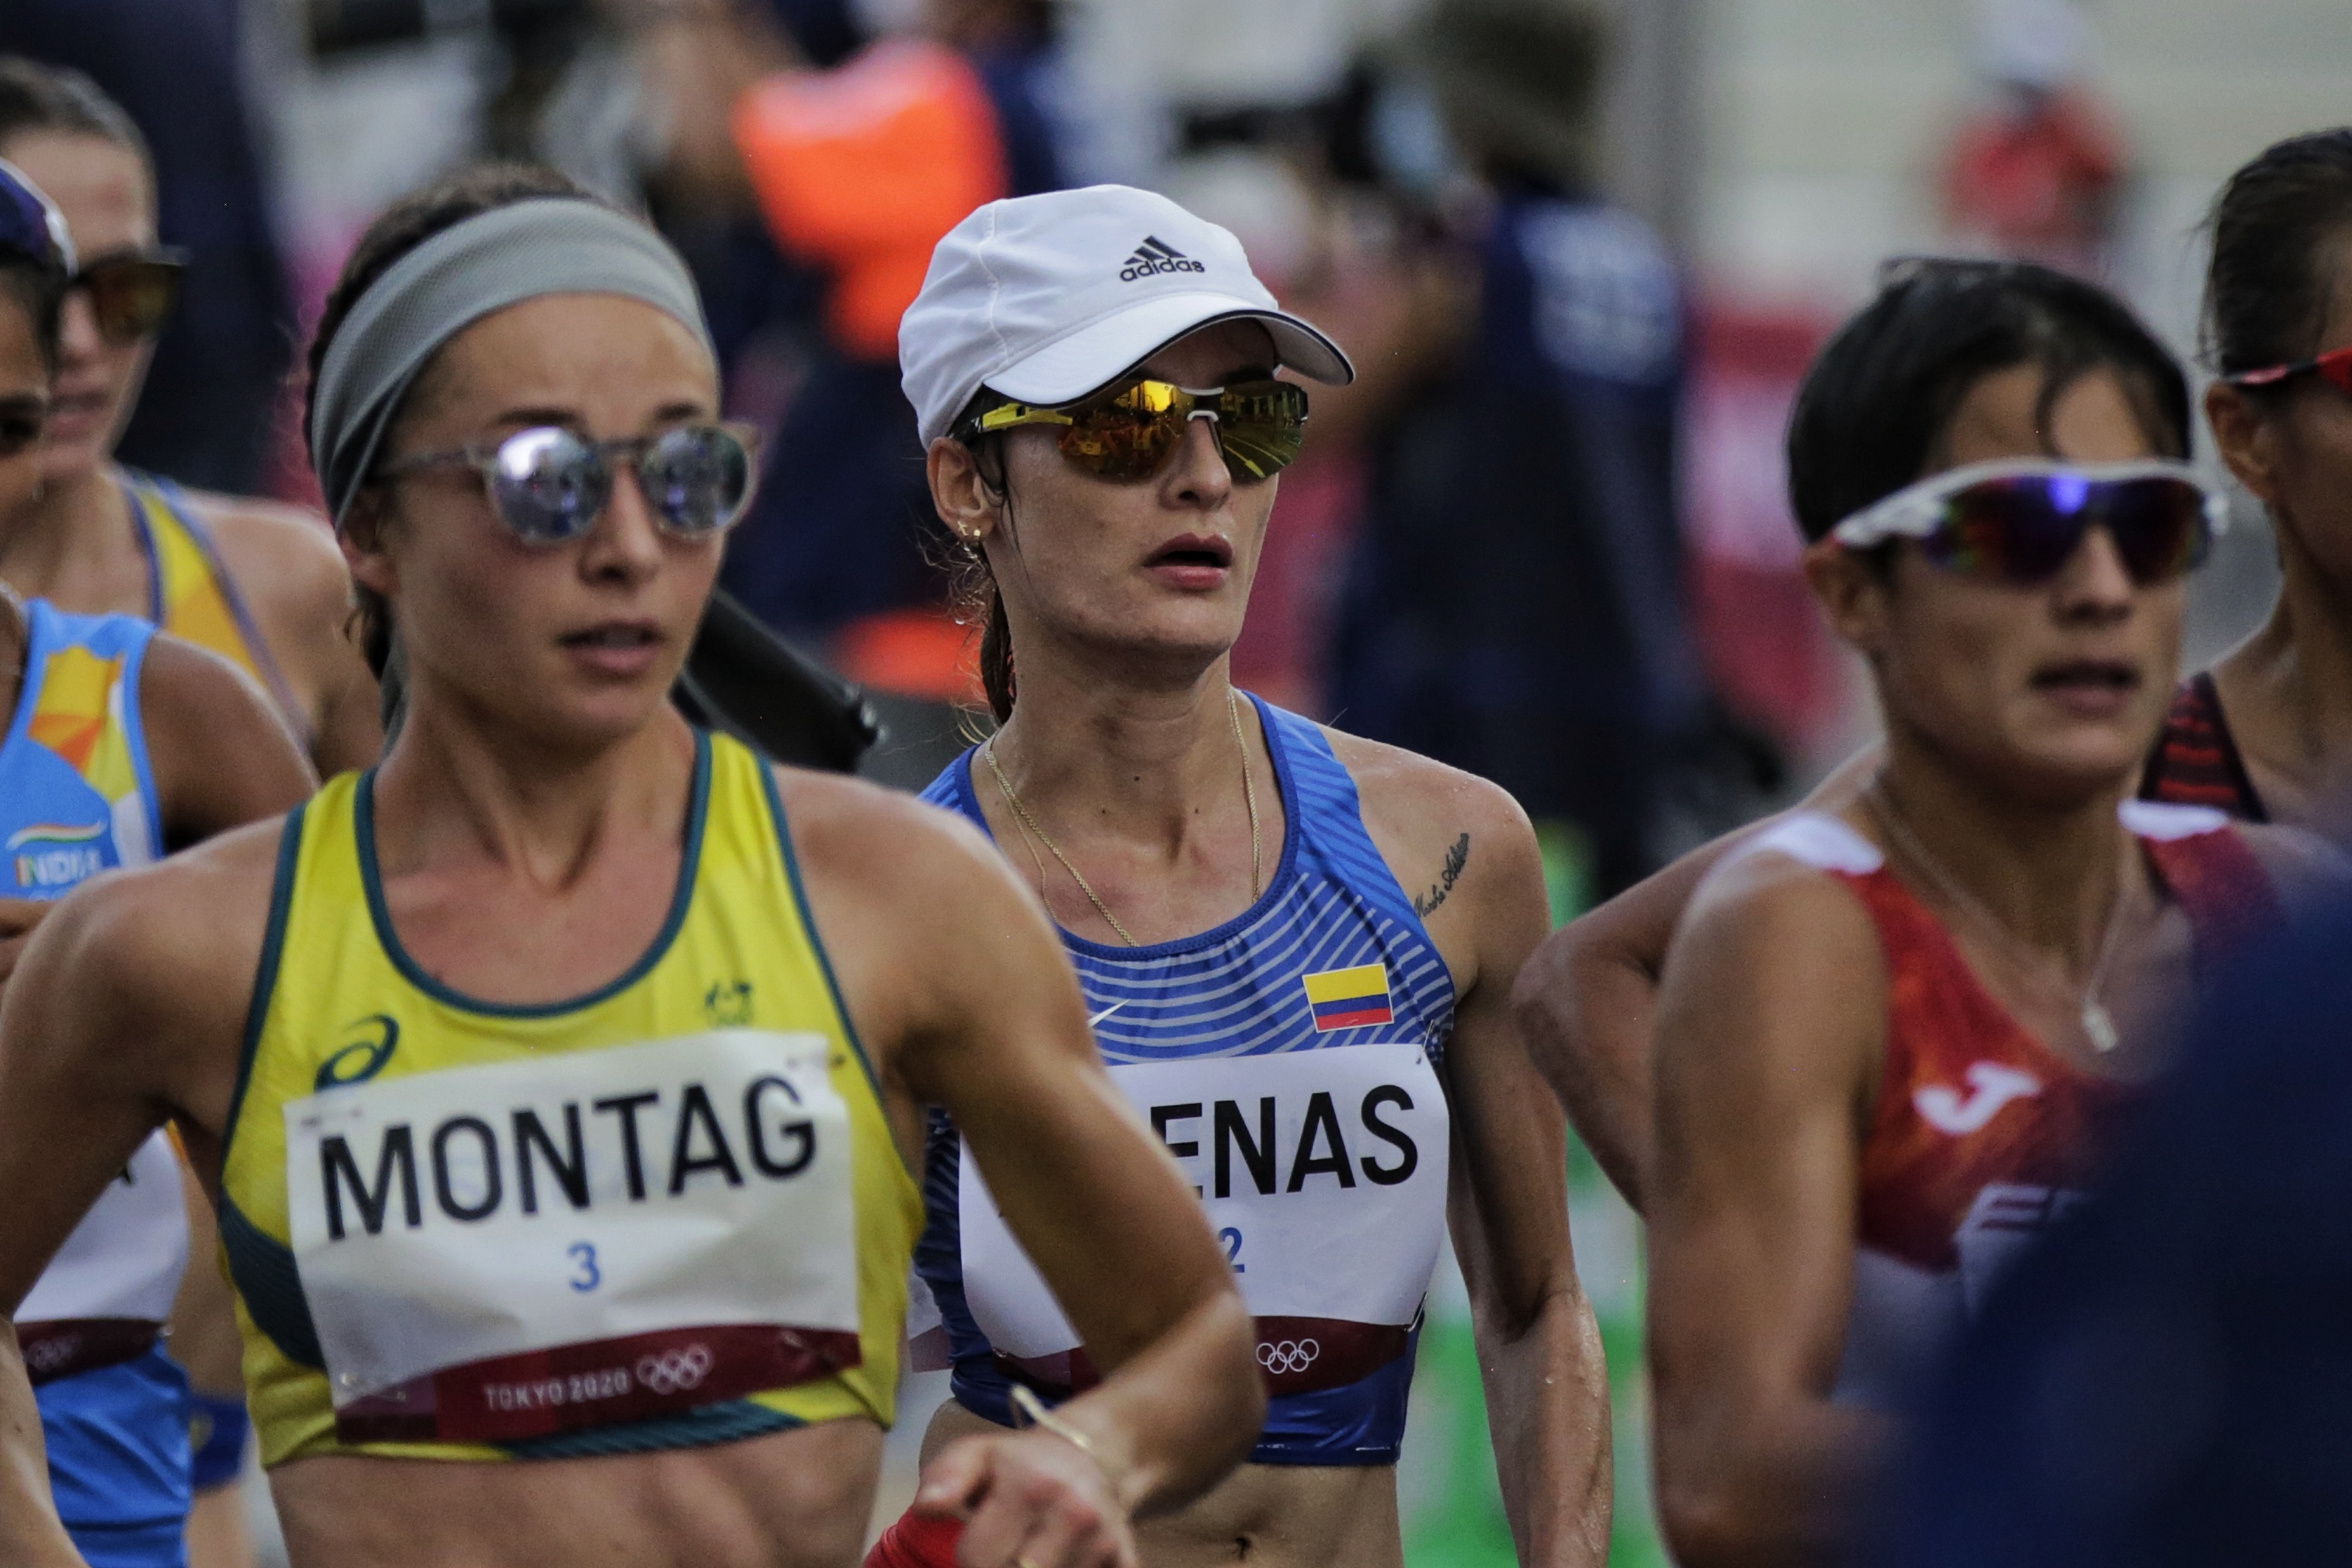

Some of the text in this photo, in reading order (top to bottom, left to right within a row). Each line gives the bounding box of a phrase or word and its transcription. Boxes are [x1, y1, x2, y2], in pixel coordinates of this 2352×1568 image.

[1120, 258, 1205, 281] adidas
[319, 1076, 817, 1240] MONTAG
[568, 1242, 601, 1292] 3
[484, 1369, 630, 1410] TOKYO 2020
